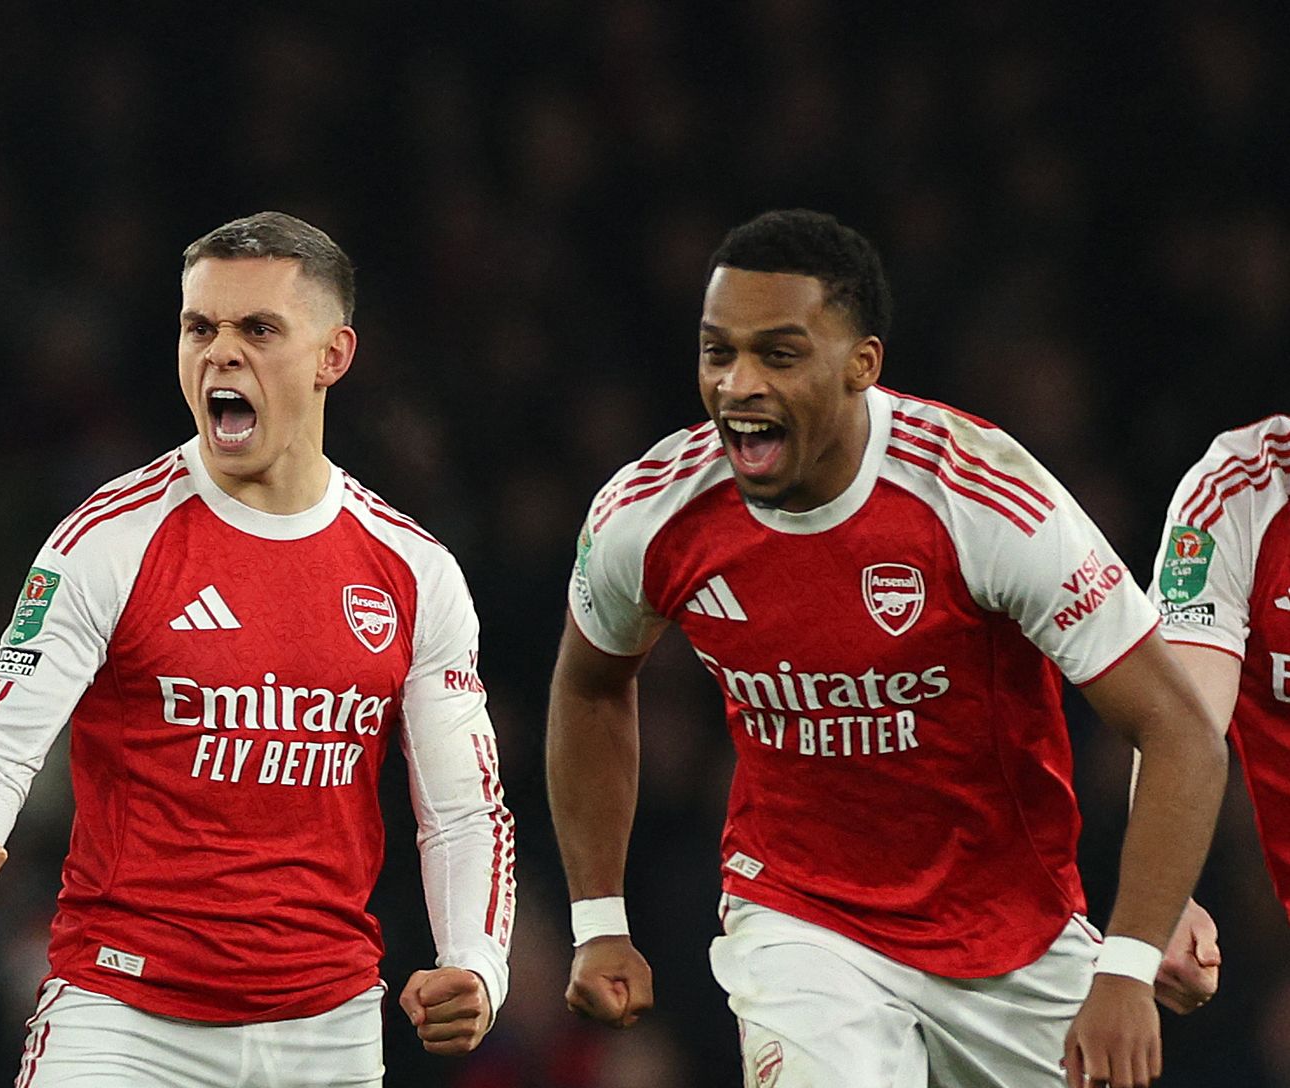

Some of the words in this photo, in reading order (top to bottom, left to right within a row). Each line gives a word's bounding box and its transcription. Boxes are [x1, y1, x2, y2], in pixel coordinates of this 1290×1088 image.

[351, 595, 389, 610] Arsenal
[872, 575, 916, 588] Arsenal
[1053, 564, 1128, 632] RWAND
[155, 672, 392, 736] Emirates
[798, 709, 919, 757] BETTER
[191, 734, 254, 783] FLY
[258, 740, 364, 787] BETTER
